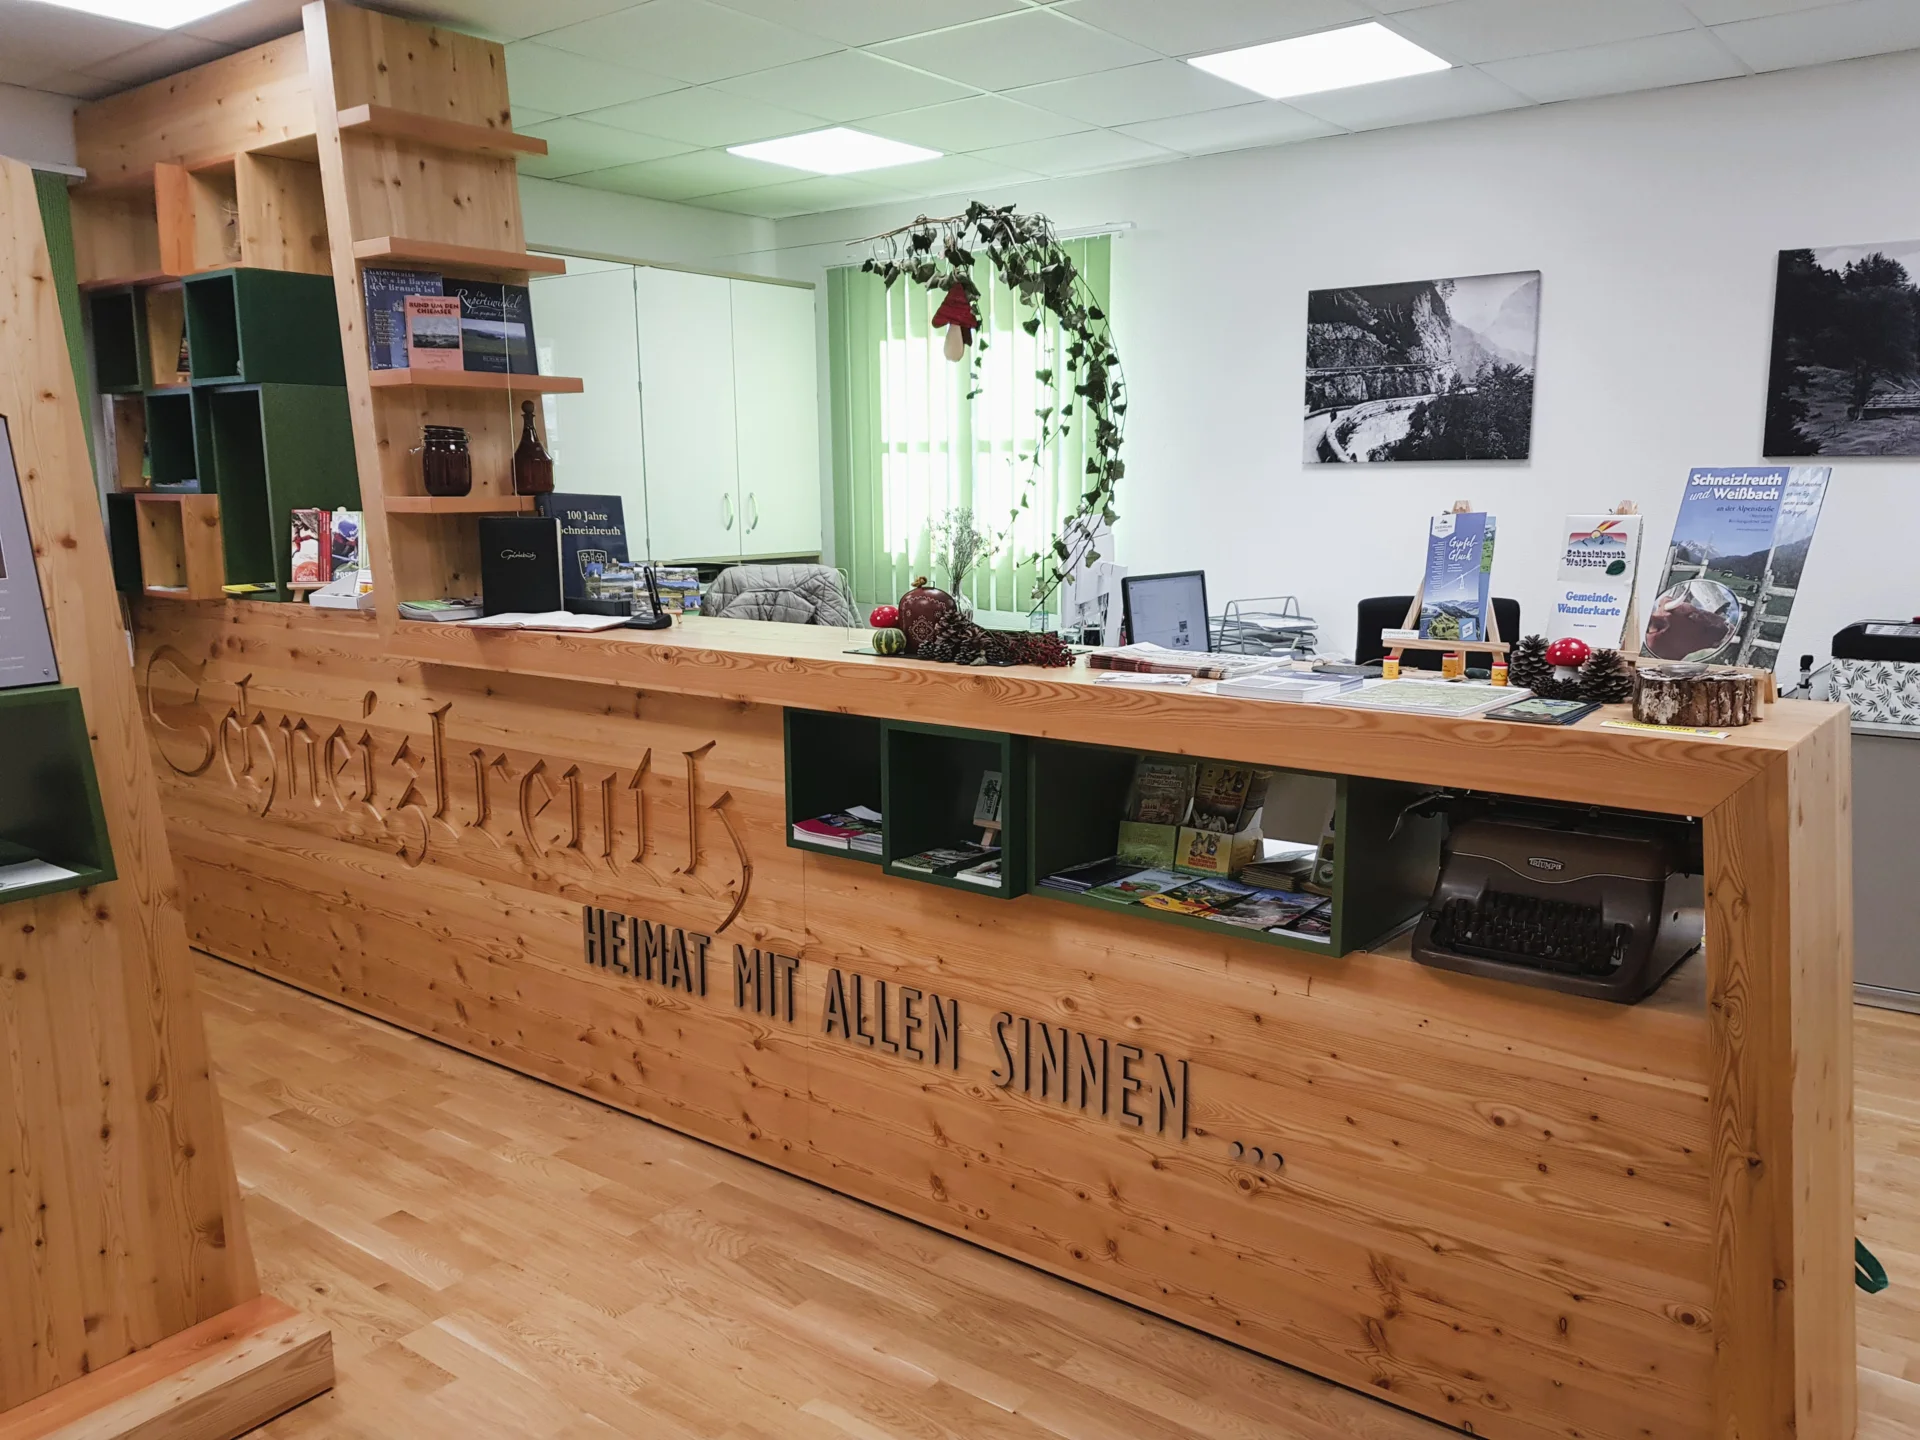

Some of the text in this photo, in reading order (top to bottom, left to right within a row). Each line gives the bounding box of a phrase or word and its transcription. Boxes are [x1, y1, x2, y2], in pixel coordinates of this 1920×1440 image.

[388, 284, 421, 292] Brauch
[1692, 472, 1782, 486] Schneizlreuth
[1689, 488, 1712, 501] und
[1713, 488, 1779, 500] Weißbach
[1737, 505, 1775, 513] Alpenstraße
[567, 511, 608, 522] 100 Jahre
[1449, 535, 1478, 550] Gipfel-
[1449, 548, 1472, 561] Glück
[1566, 549, 1626, 559] Schneizlreuth
[1566, 558, 1608, 568] Weißbach
[1566, 591, 1617, 602] Gemeinde-
[1557, 603, 1621, 616] Wanderkarte
[145, 643, 754, 934] Schneizlreuth
[1528, 857, 1564, 871] TRIUMPH
[582, 905, 711, 997] HEIMAT
[732, 943, 800, 1023] MIT
[820, 967, 960, 1072] ALLEN
[989, 1011, 1189, 1140] SINNEN
